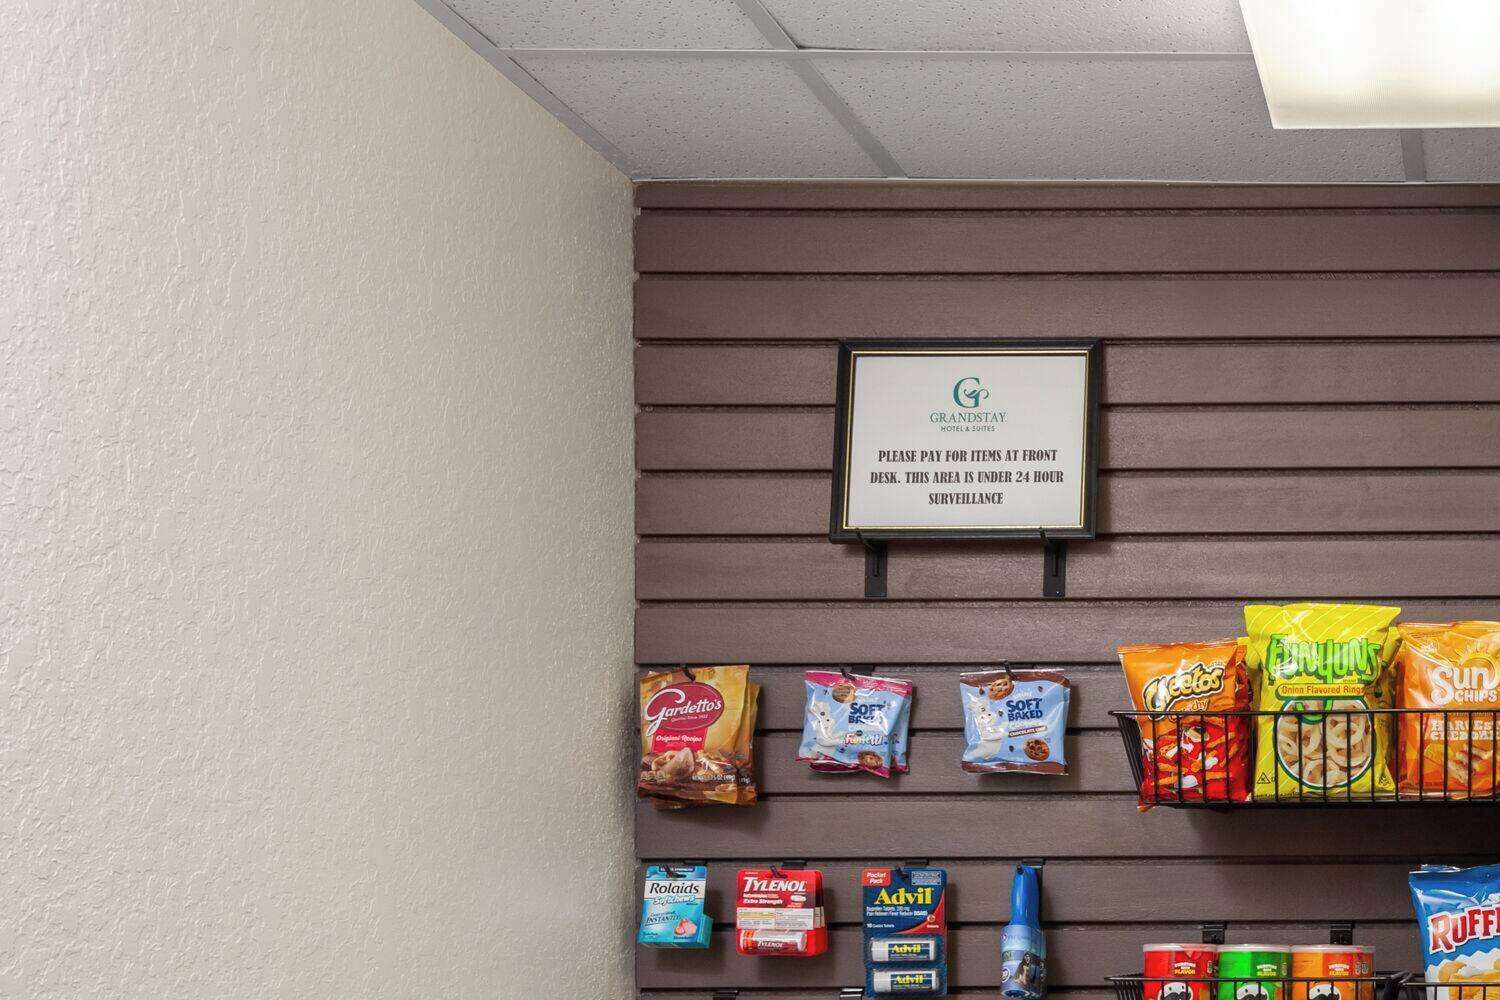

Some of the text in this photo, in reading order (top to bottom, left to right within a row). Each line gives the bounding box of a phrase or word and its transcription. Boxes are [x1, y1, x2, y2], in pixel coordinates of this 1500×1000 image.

[929, 412, 1007, 423] GRANDSTAY
[878, 450, 1058, 462] PLEASE PAY FOR ITEMS AT FRONT
[870, 471, 1064, 484] DESK. THIS AREA IS UNDER 24 HOUR
[928, 493, 1004, 505] SURVEILLANCE
[1281, 686, 1304, 694] Onion
[1306, 685, 1340, 694] Flavored
[1431, 666, 1499, 706] Sun
[1454, 689, 1499, 702] CHIPS
[849, 702, 884, 716] SOFT
[1005, 698, 1043, 713] SOFT
[646, 688, 723, 737] Gardetto's
[1008, 710, 1044, 722] BAKED
[649, 882, 700, 894] Rolaids
[743, 876, 808, 893] TYLENOL
[874, 887, 934, 905] Advil
[757, 940, 783, 948] TYLENOL
[891, 943, 922, 954] Advil
[895, 974, 925, 984] Advil
